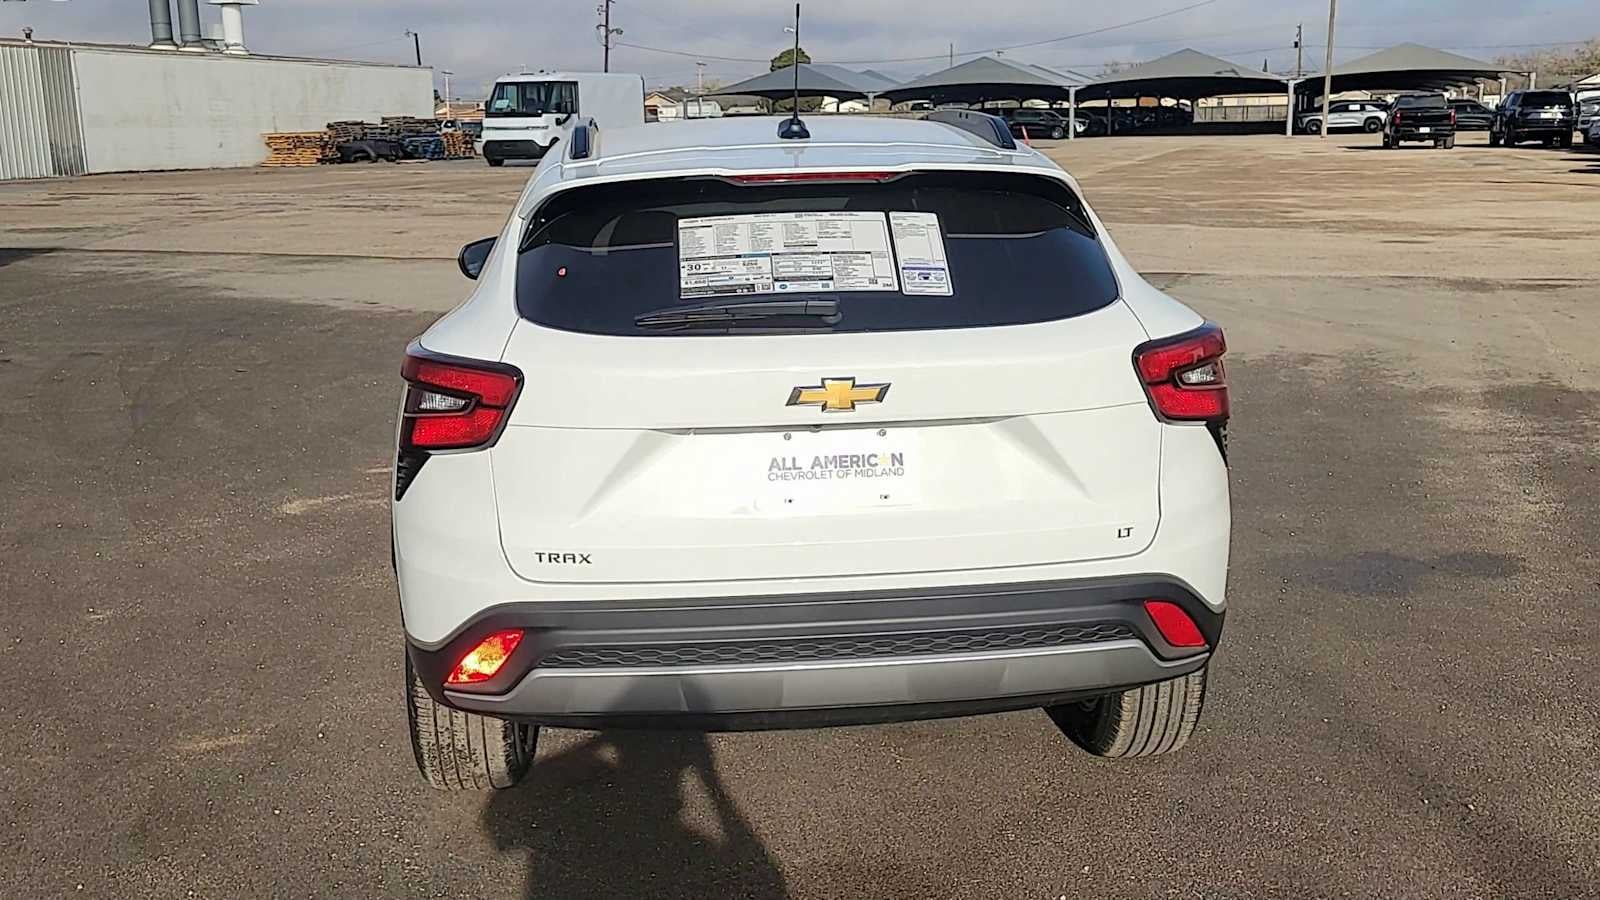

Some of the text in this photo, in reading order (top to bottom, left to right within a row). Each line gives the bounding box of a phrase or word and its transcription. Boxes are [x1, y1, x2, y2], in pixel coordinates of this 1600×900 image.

[687, 263, 701, 271] 30
[768, 453, 904, 471] ALL AMERICN
[768, 467, 904, 482] CHEVROLET OF MIDLAND
[1118, 527, 1135, 538] LT
[535, 552, 592, 564] TRAX
